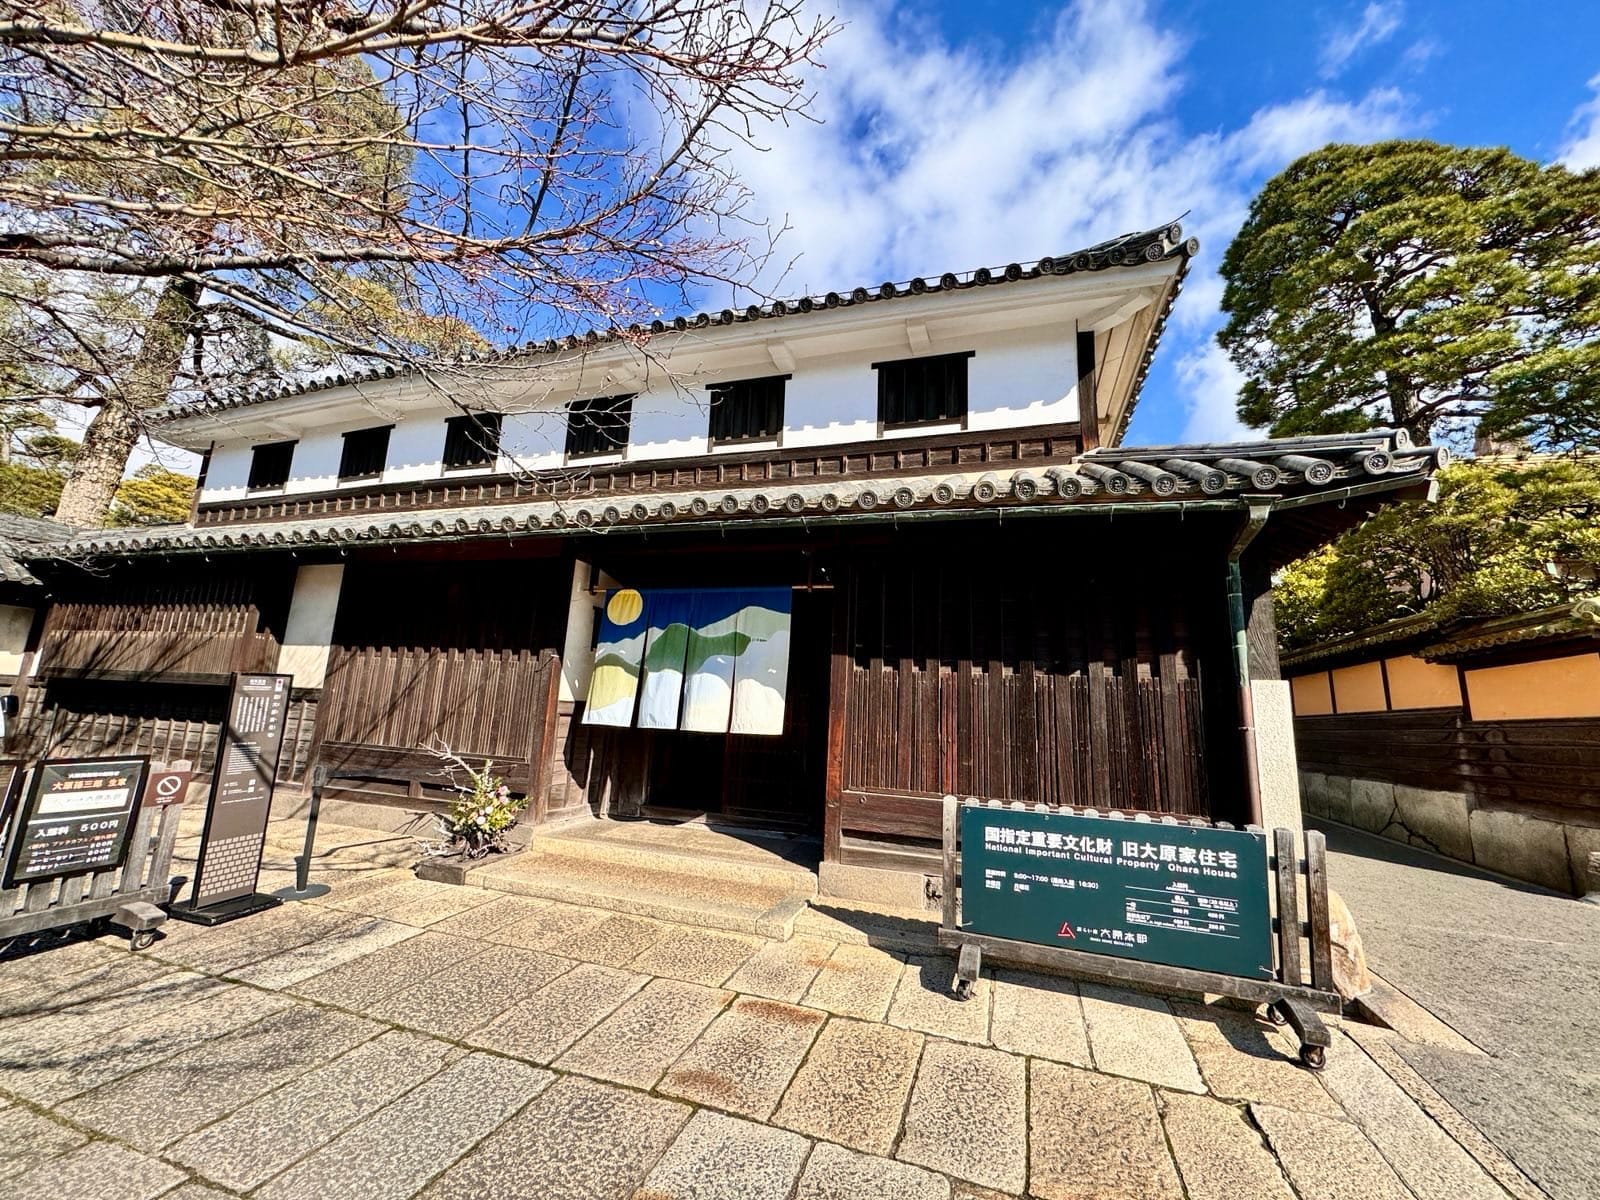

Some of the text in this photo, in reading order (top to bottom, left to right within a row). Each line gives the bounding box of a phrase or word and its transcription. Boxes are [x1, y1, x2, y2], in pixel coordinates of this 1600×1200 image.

[80, 820, 119, 832] 500円
[984, 826, 1238, 869] 国指定重要文化財 旧大原家住宅
[985, 842, 1238, 879] National Important Cultural Property Ohara House
